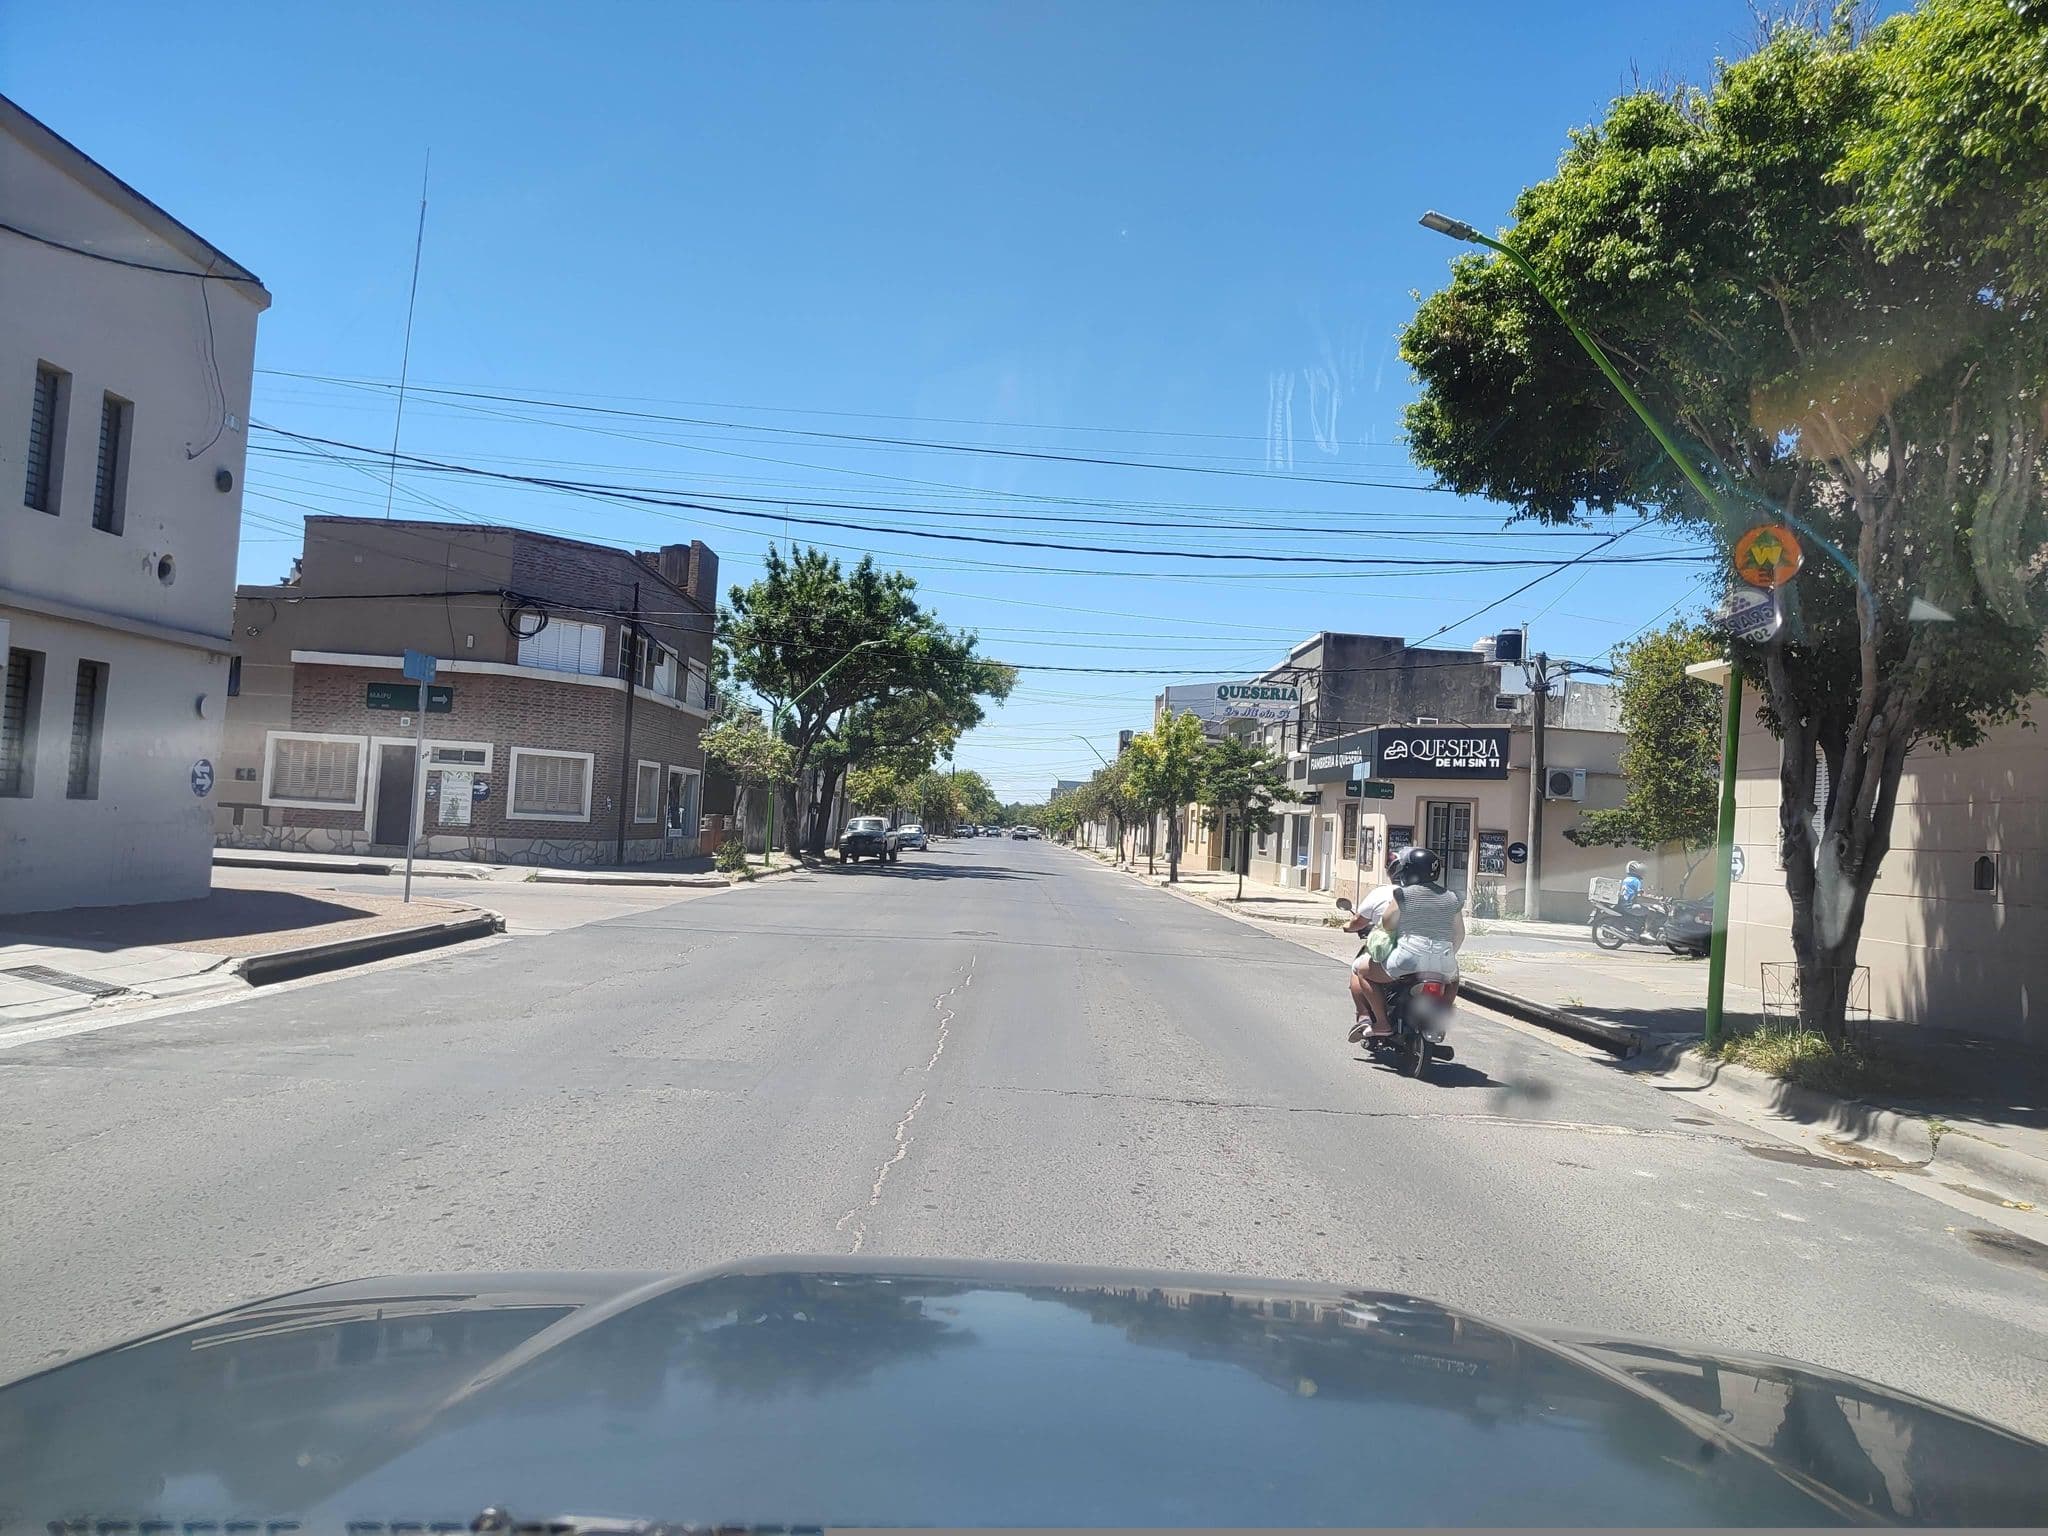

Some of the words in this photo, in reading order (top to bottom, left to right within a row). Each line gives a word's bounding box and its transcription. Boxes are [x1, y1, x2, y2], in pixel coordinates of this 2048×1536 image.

[1217, 685, 1299, 701] QUESERIA
[1410, 739, 1500, 761] QUESERIA
[1435, 758, 1451, 768] DE
[1453, 758, 1466, 768] MI
[1467, 758, 1487, 768] SIN
[1489, 758, 1500, 768] TI
